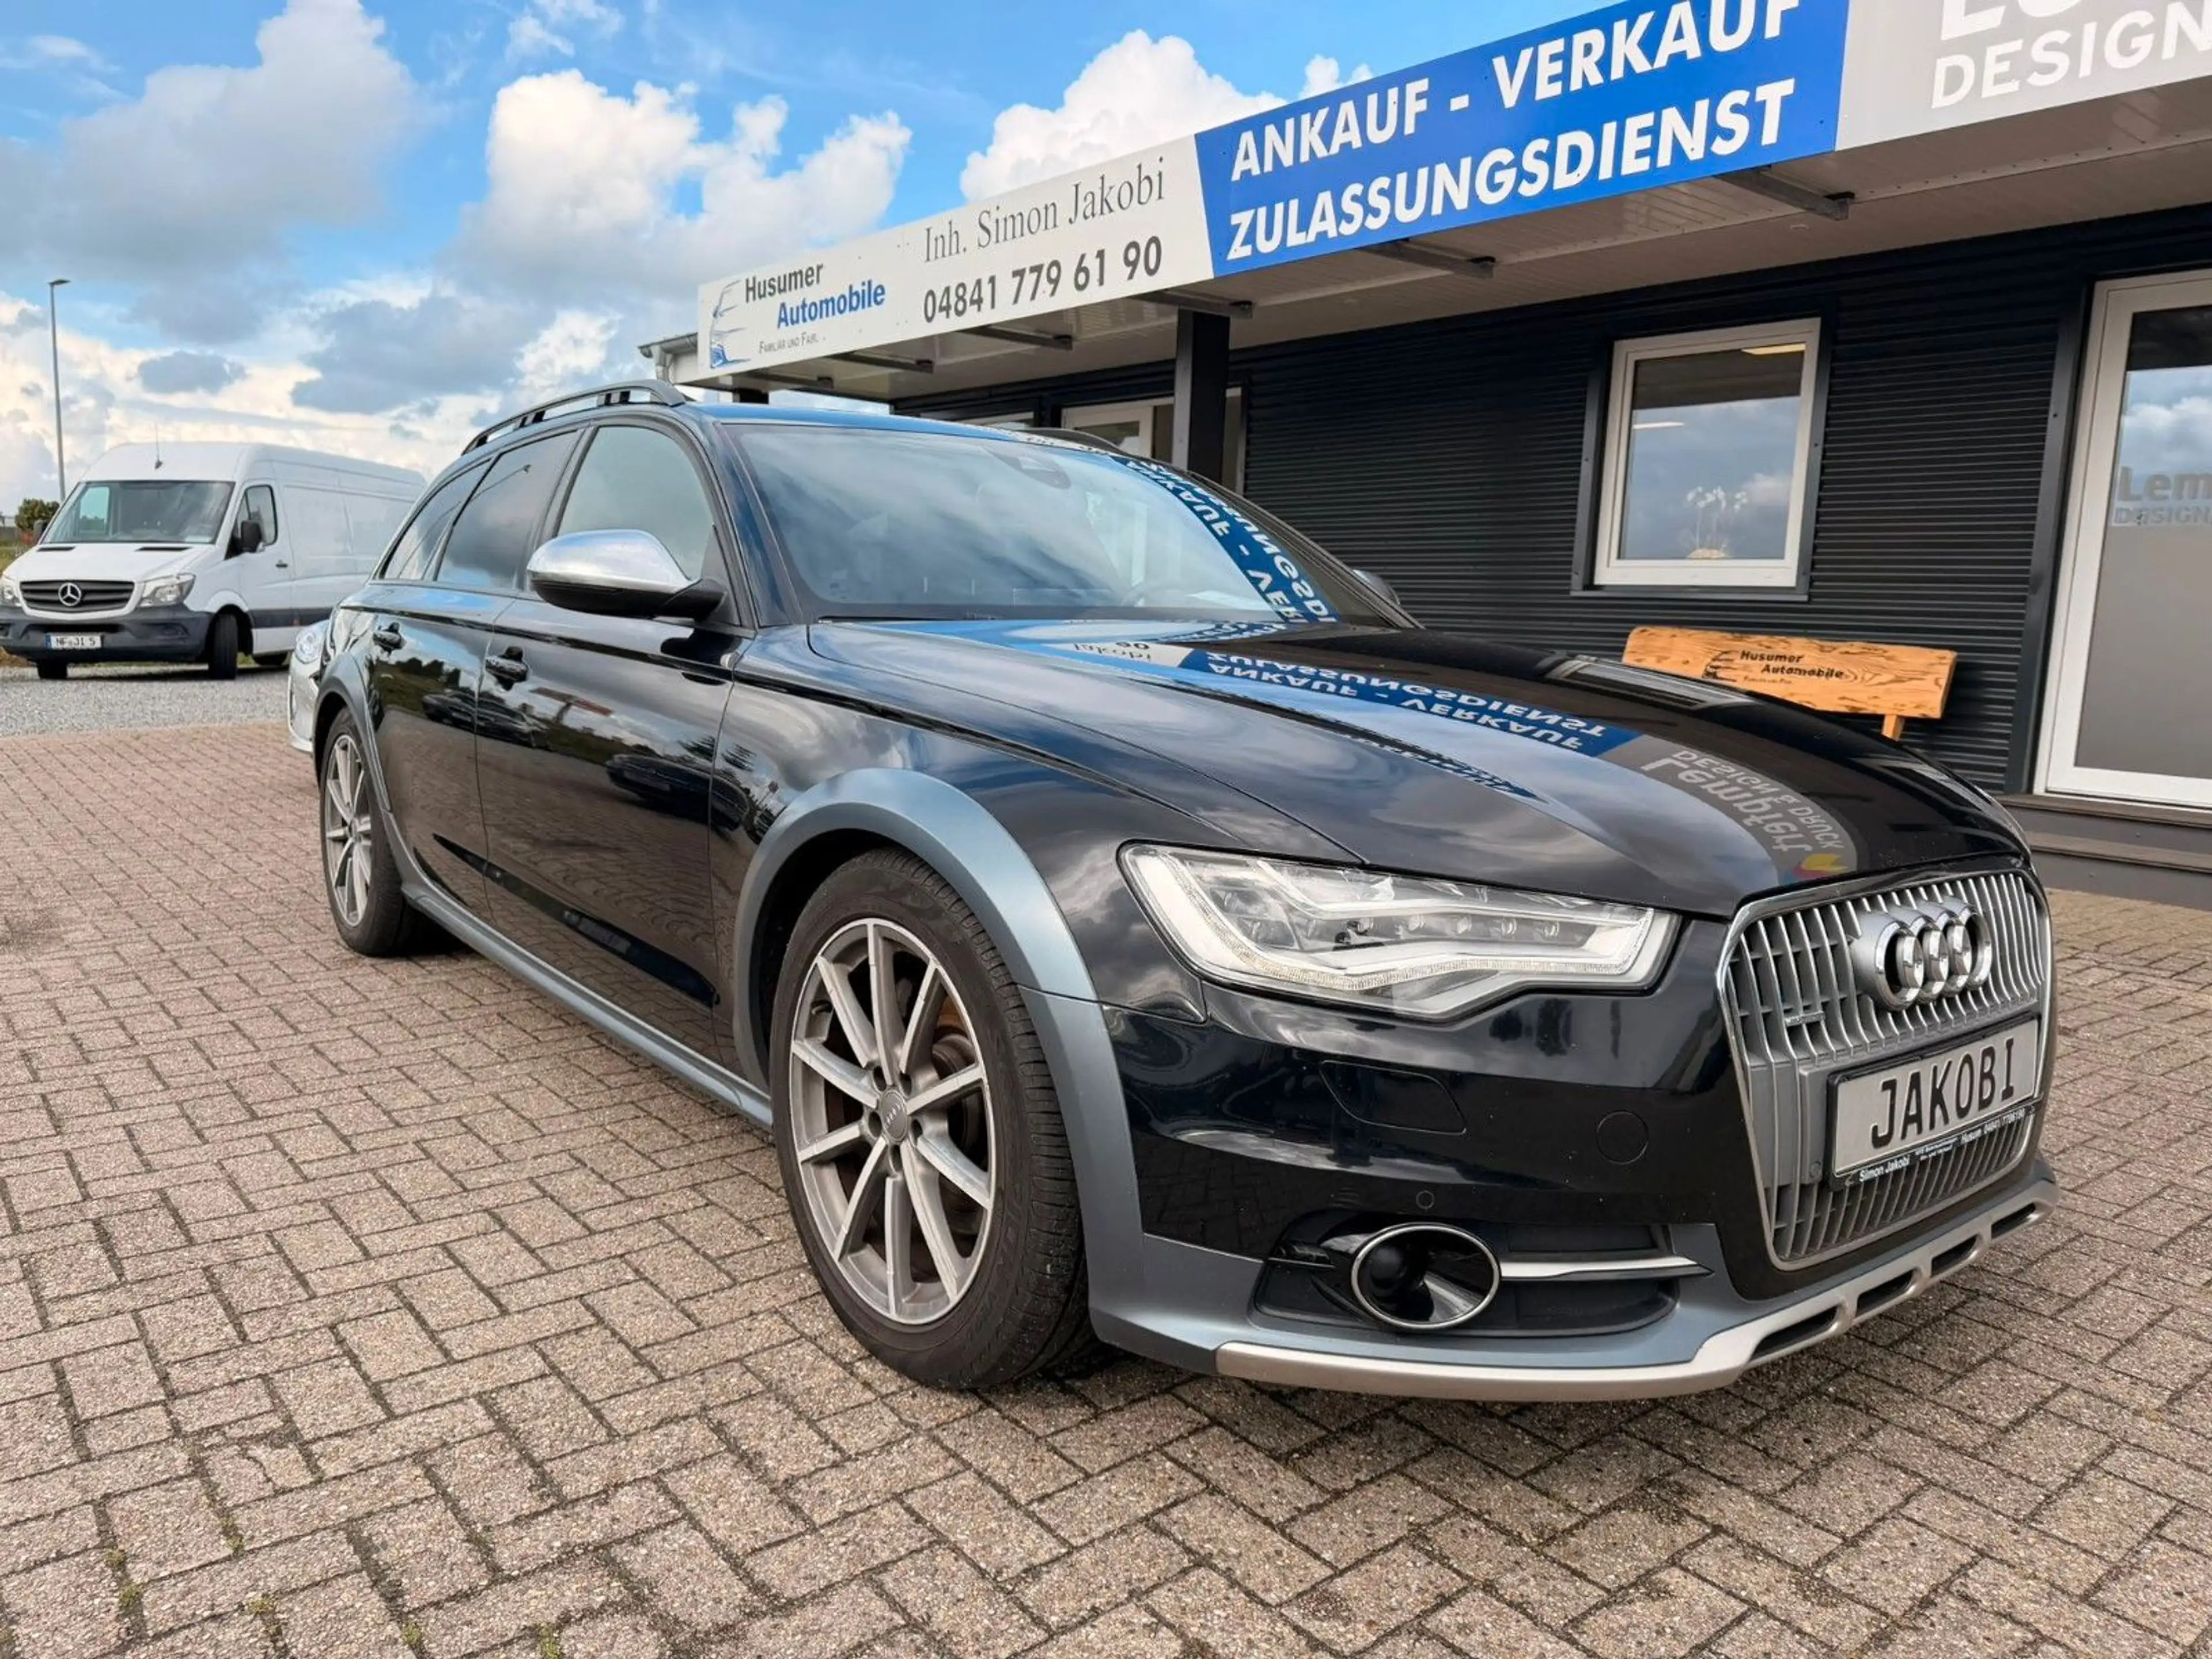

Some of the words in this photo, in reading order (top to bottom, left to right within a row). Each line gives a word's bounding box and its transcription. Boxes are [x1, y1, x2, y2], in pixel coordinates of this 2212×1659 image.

[1231, 78, 1429, 181] ANKAUF
[1450, 94, 1469, 111] -
[1492, 0, 1800, 109] VERKAUF
[1931, 0, 2212, 109] DESIGN
[924, 219, 967, 263] Inh.
[978, 200, 1058, 249] Simon
[1068, 156, 1165, 225] Jakobi
[1226, 78, 1796, 261] ZULASSUNGSDIENST
[745, 263, 824, 304] Husumer
[778, 278, 886, 329] Automobile
[923, 275, 997, 323] 04841
[1012, 260, 1062, 305] 779
[1074, 249, 1105, 292] 61
[1123, 236, 1162, 281] 90
[1740, 649, 1805, 664] Husumer
[1761, 664, 1844, 680] Automobile
[1871, 1037, 2014, 1149] JAKOBI
